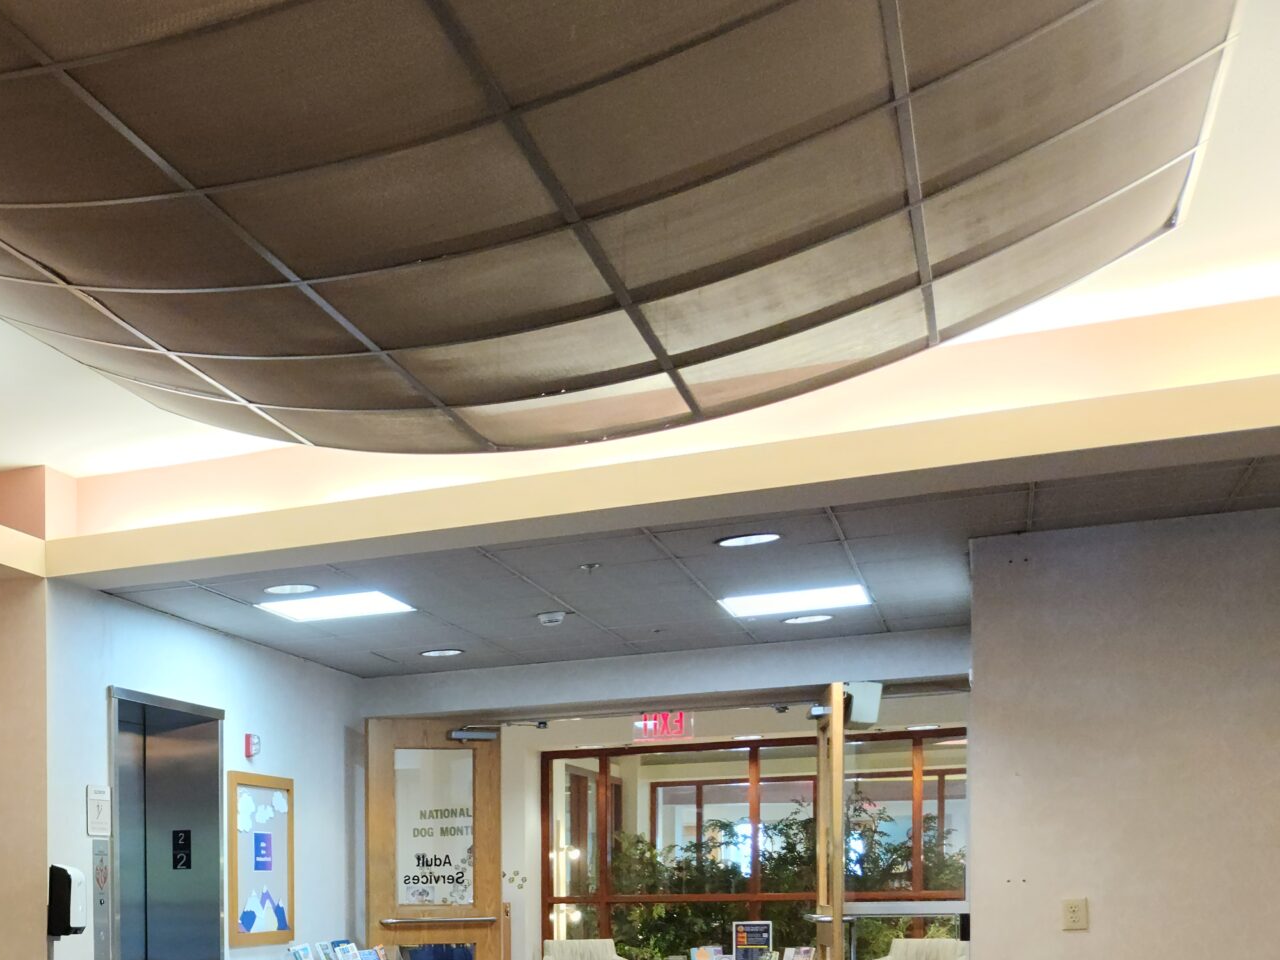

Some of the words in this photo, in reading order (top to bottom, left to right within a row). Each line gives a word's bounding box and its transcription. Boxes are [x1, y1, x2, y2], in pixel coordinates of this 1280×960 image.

[420, 807, 473, 820] NATIONAL
[178, 832, 185, 844] 2
[413, 827, 434, 838] DOG
[176, 853, 187, 869] 2
